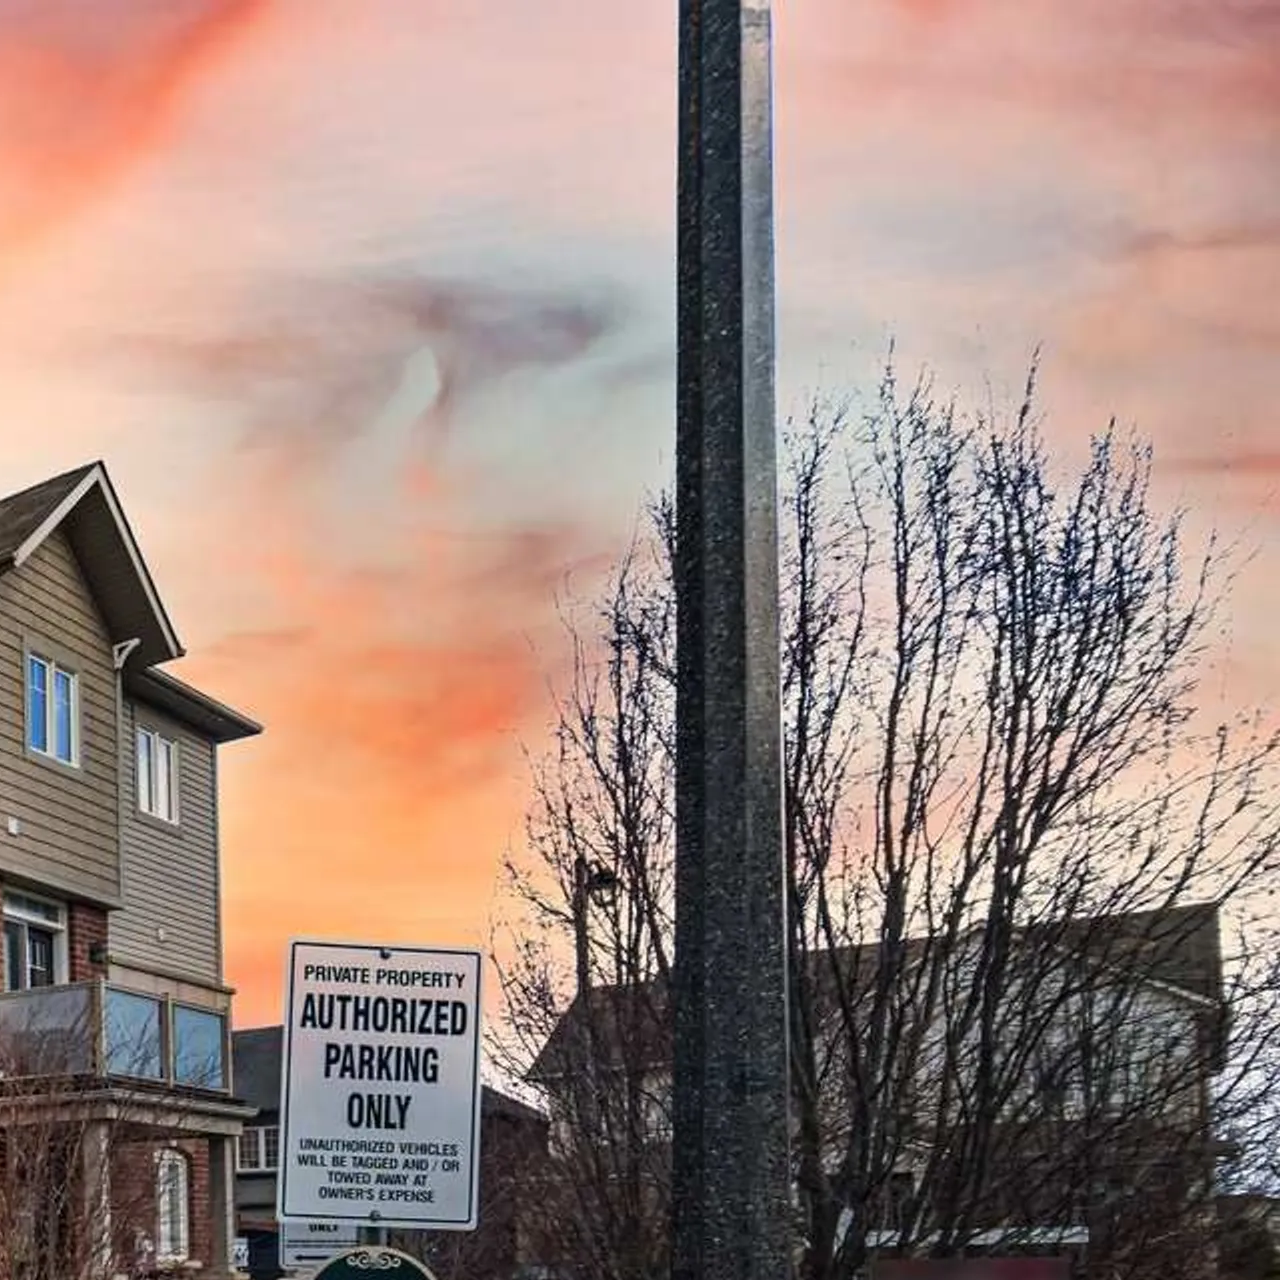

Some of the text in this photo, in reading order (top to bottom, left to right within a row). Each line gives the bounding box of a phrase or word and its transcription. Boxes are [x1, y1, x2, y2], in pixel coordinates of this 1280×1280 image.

[304, 965, 466, 988] PRIVATE PROPERTY
[300, 993, 467, 1035] AUTHORIZED
[324, 1043, 439, 1083] PARKING
[347, 1092, 412, 1130] ONLY
[300, 1139, 459, 1157] UNAUTHORIZED VEHICLES
[297, 1155, 328, 1167] WILL
[332, 1156, 347, 1168] BE
[352, 1156, 399, 1170] TAGGED
[402, 1159, 429, 1172] AND
[442, 1160, 460, 1173] OR
[327, 1171, 429, 1187] TOWED AWAY AT
[319, 1187, 436, 1203] OWNER'S EXPENSE
